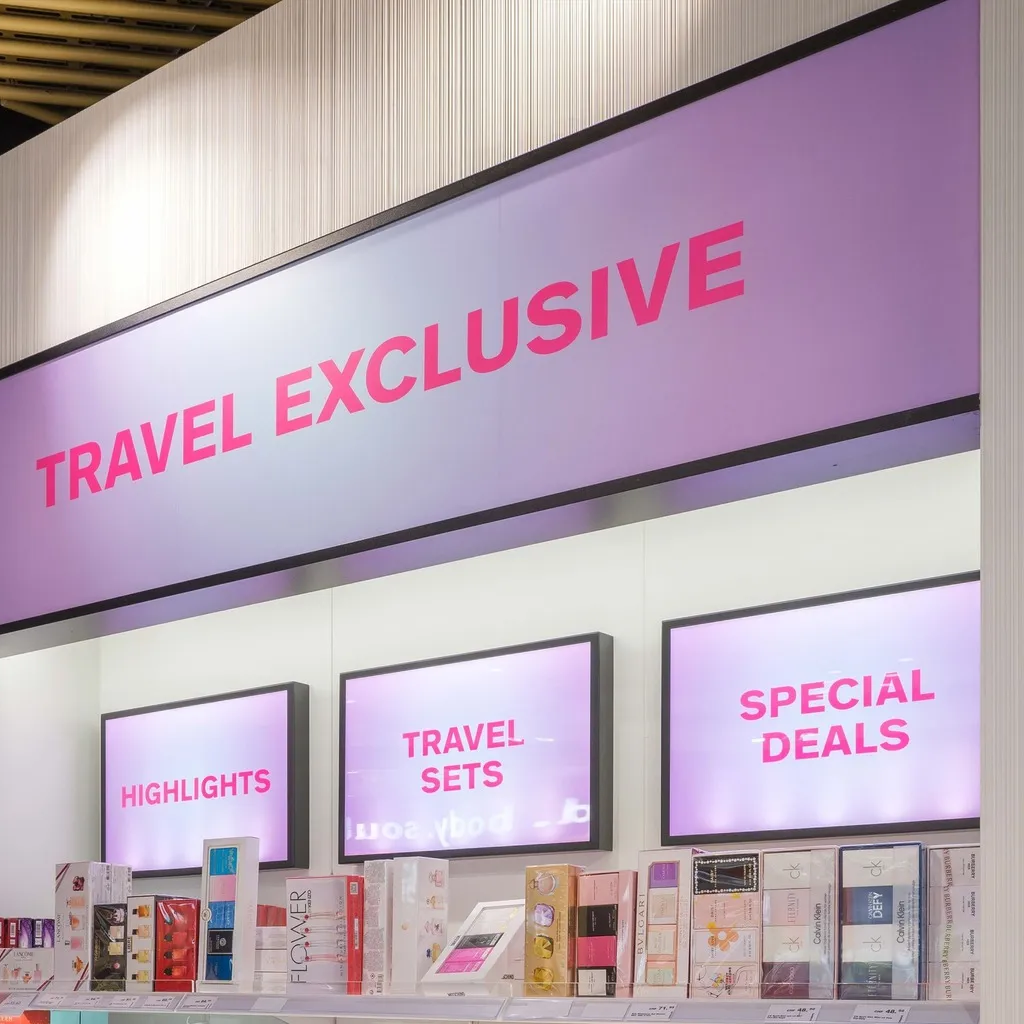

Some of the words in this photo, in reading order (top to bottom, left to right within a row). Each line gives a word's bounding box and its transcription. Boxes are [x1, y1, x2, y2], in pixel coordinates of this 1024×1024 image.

[35, 394, 252, 507] TRAVEL
[275, 221, 745, 436] EXCLUSIVE
[740, 669, 936, 721] SPECIAL
[402, 719, 525, 758] TRAVEL
[762, 718, 910, 763] DEALS
[121, 768, 271, 808] HIGHLIGHTS
[421, 760, 504, 794] SETS
[782, 862, 801, 880] ck
[862, 860, 883, 878] ck
[813, 902, 822, 919] Klein
[872, 892, 883, 919] DEFY
[896, 900, 906, 917] Klein
[289, 890, 308, 984] FLOWER
[637, 893, 645, 955] BVLGARI
[813, 920, 822, 945] Calvin
[896, 918, 906, 944] Calvin
[782, 936, 801, 953] ck
[862, 934, 883, 953] ck
